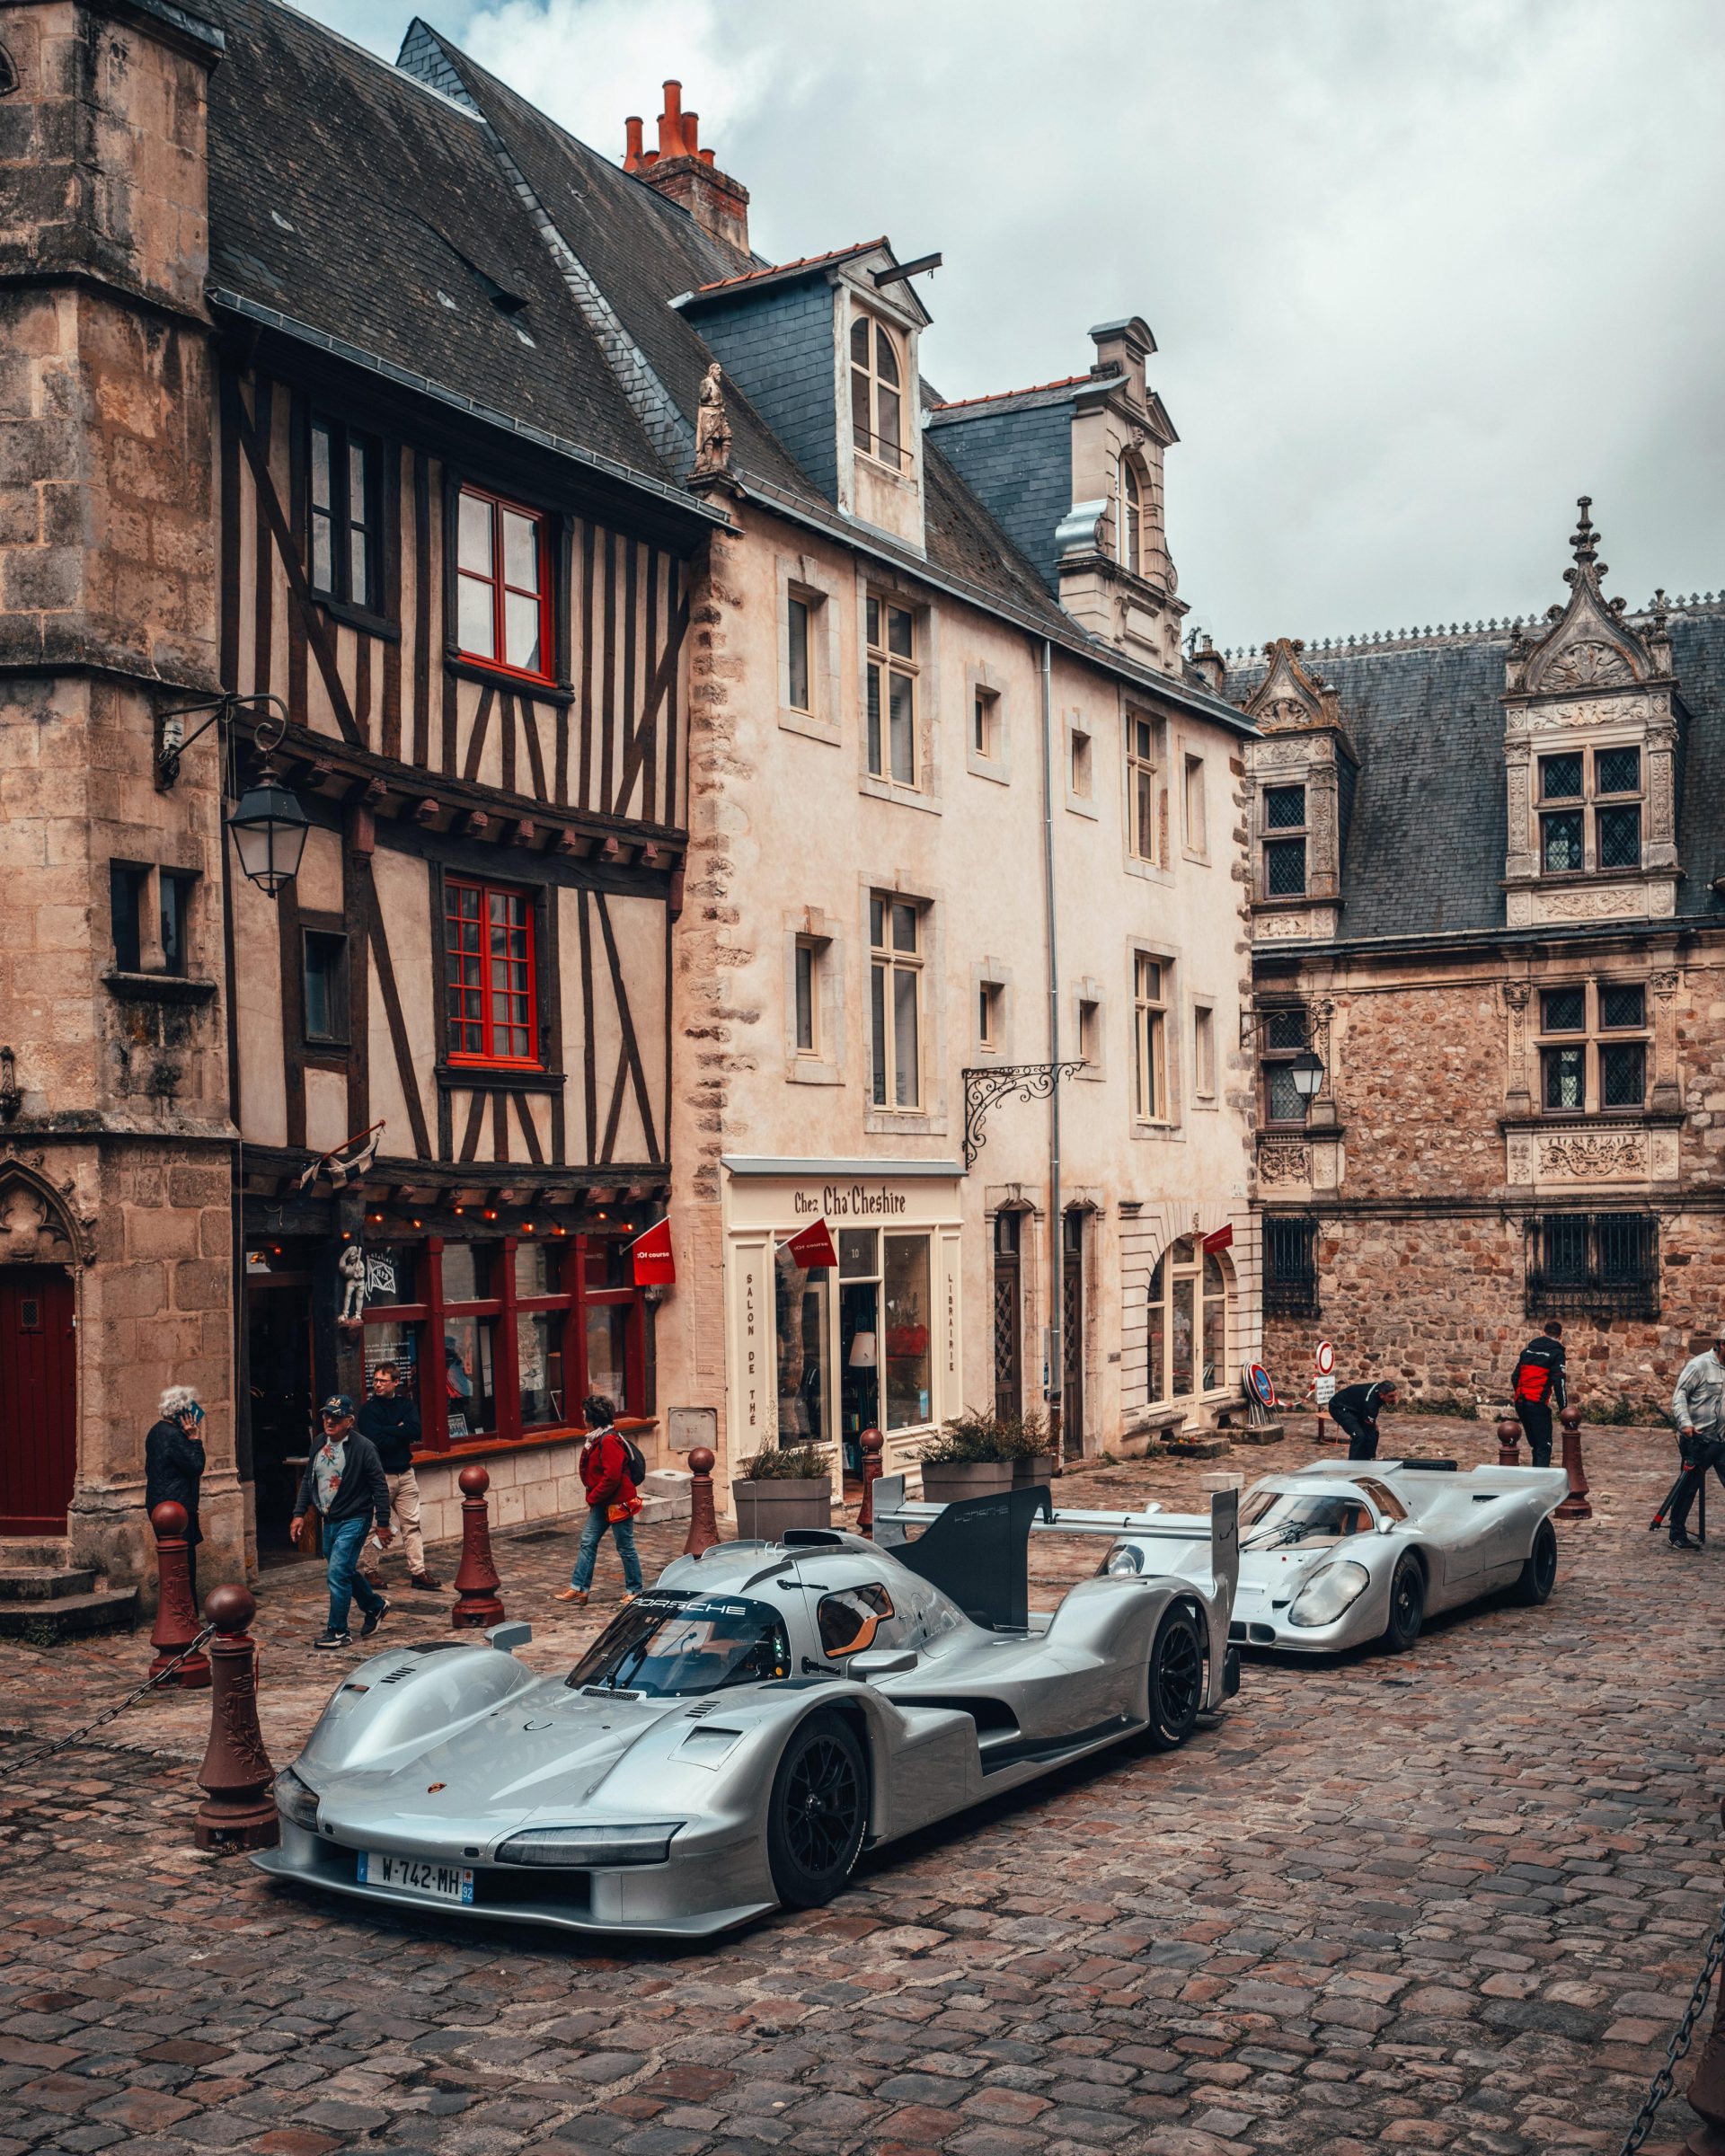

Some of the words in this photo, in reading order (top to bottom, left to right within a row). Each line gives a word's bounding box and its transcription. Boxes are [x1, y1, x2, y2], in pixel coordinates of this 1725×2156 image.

[794, 1191, 818, 1214] Chez
[851, 1249, 860, 1259] 10
[748, 1351, 755, 1374] DE
[629, 1598, 747, 1615] PORSCHE
[463, 1886, 473, 1899] 92
